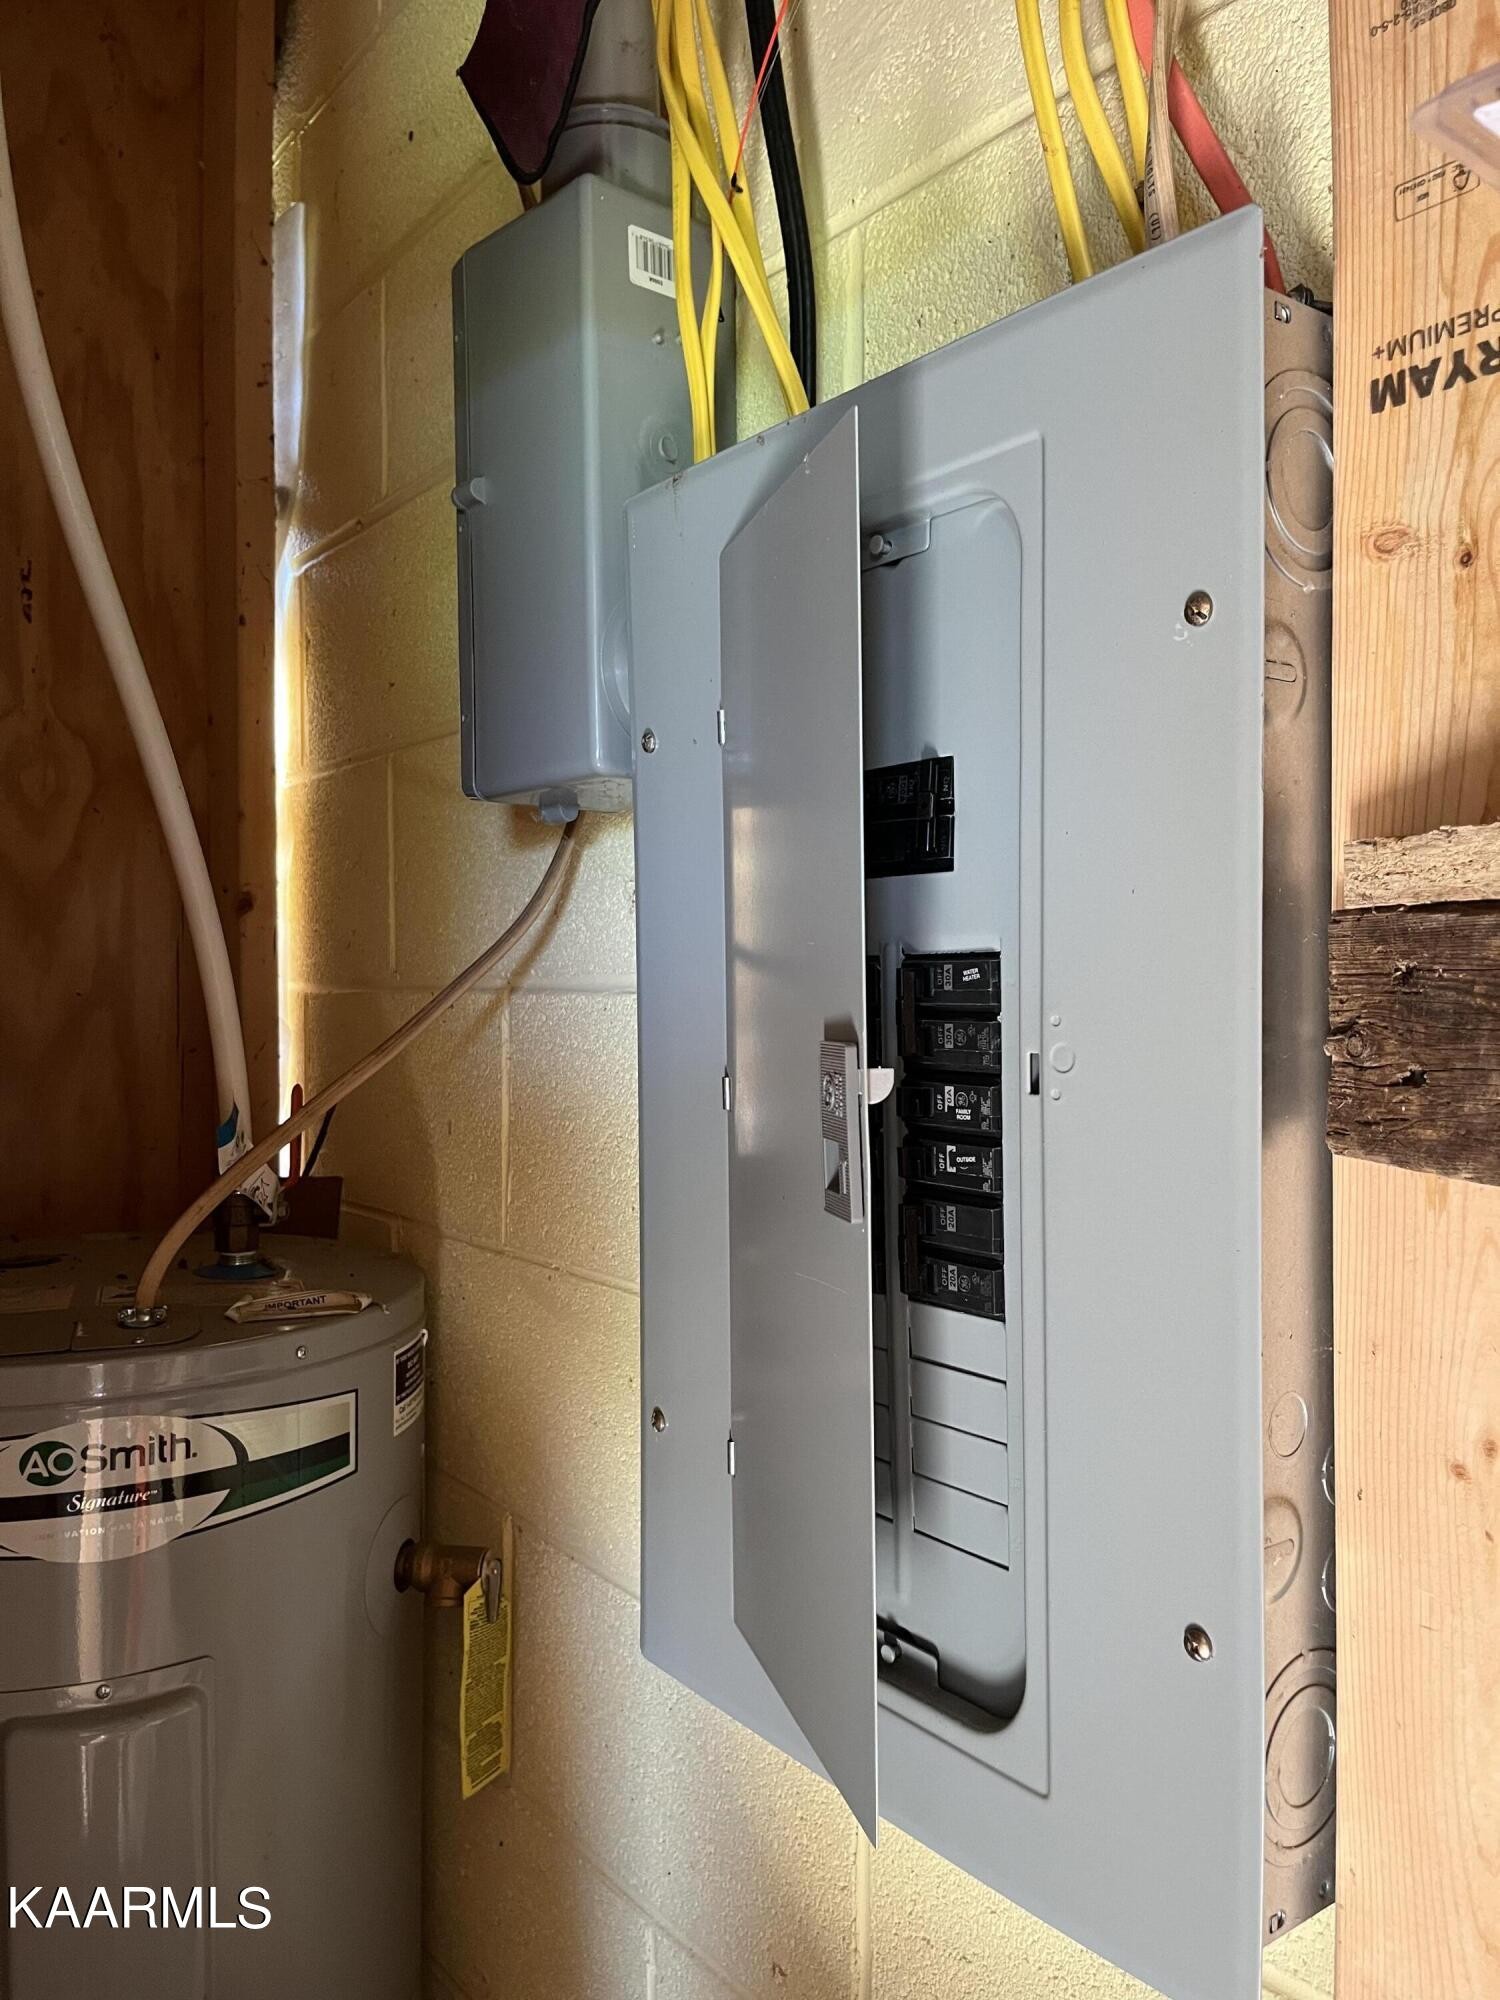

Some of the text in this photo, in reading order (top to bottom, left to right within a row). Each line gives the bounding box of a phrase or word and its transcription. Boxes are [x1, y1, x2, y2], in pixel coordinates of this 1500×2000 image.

[1149, 213, 1161, 241] (UL)
[1370, 337, 1500, 414] RYAM
[947, 1209, 955, 1229] 20A
[264, 1295, 327, 1311] IMPORTANT
